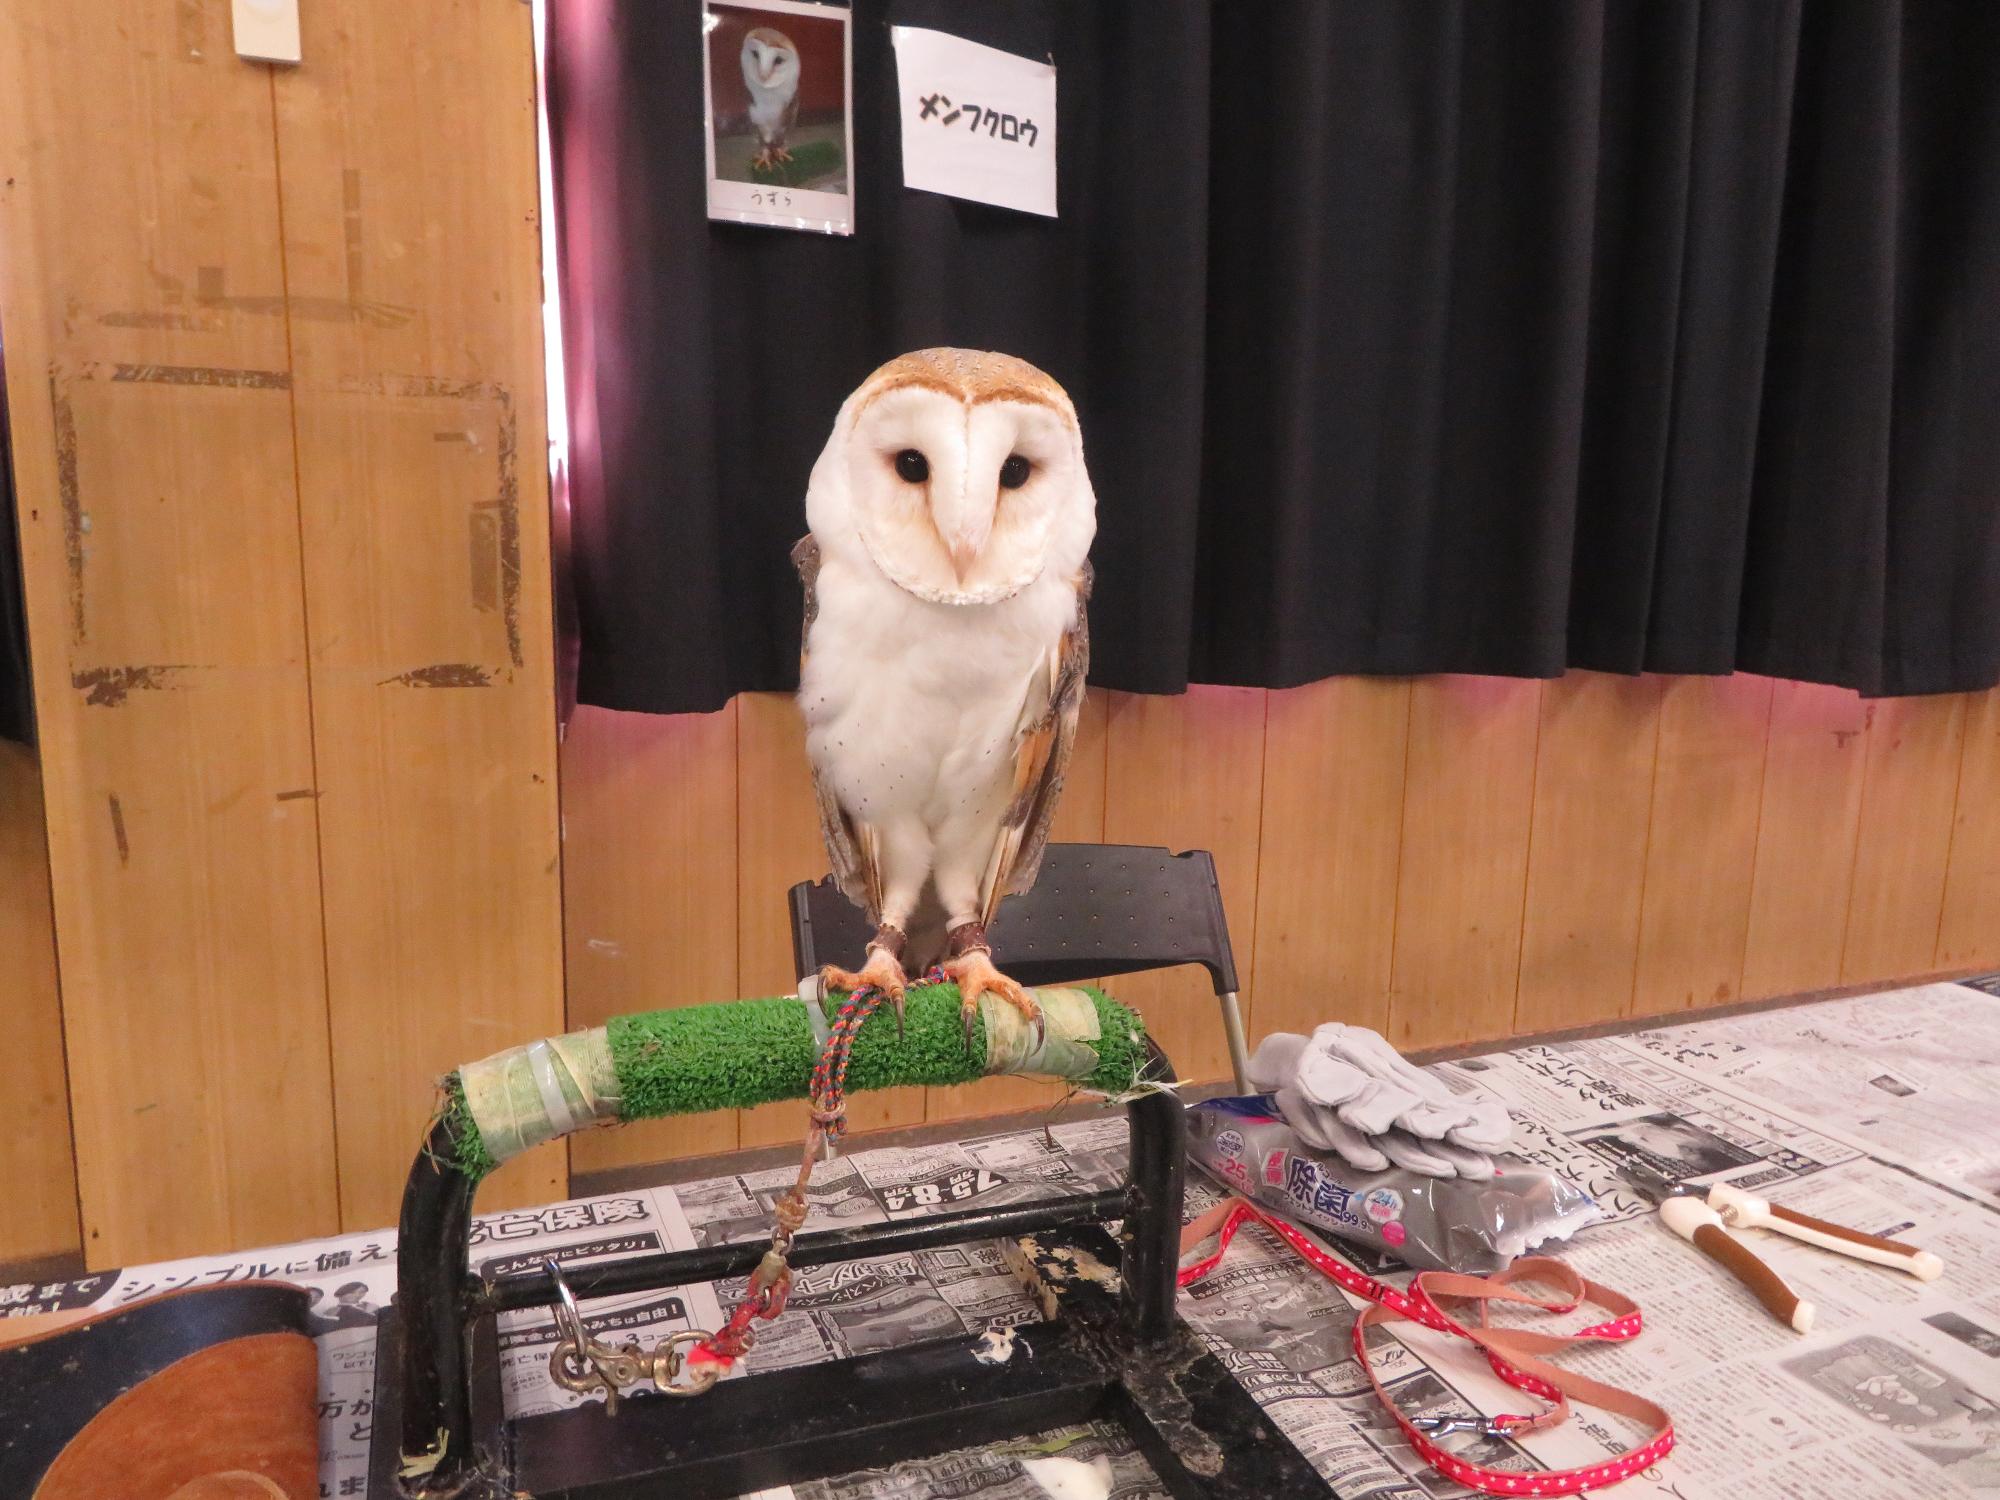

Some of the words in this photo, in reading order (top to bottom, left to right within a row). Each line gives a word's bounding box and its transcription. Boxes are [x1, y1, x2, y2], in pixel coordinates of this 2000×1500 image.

[919, 92, 1039, 148] メンフクロウ
[1287, 1157, 1354, 1222] 除菌
